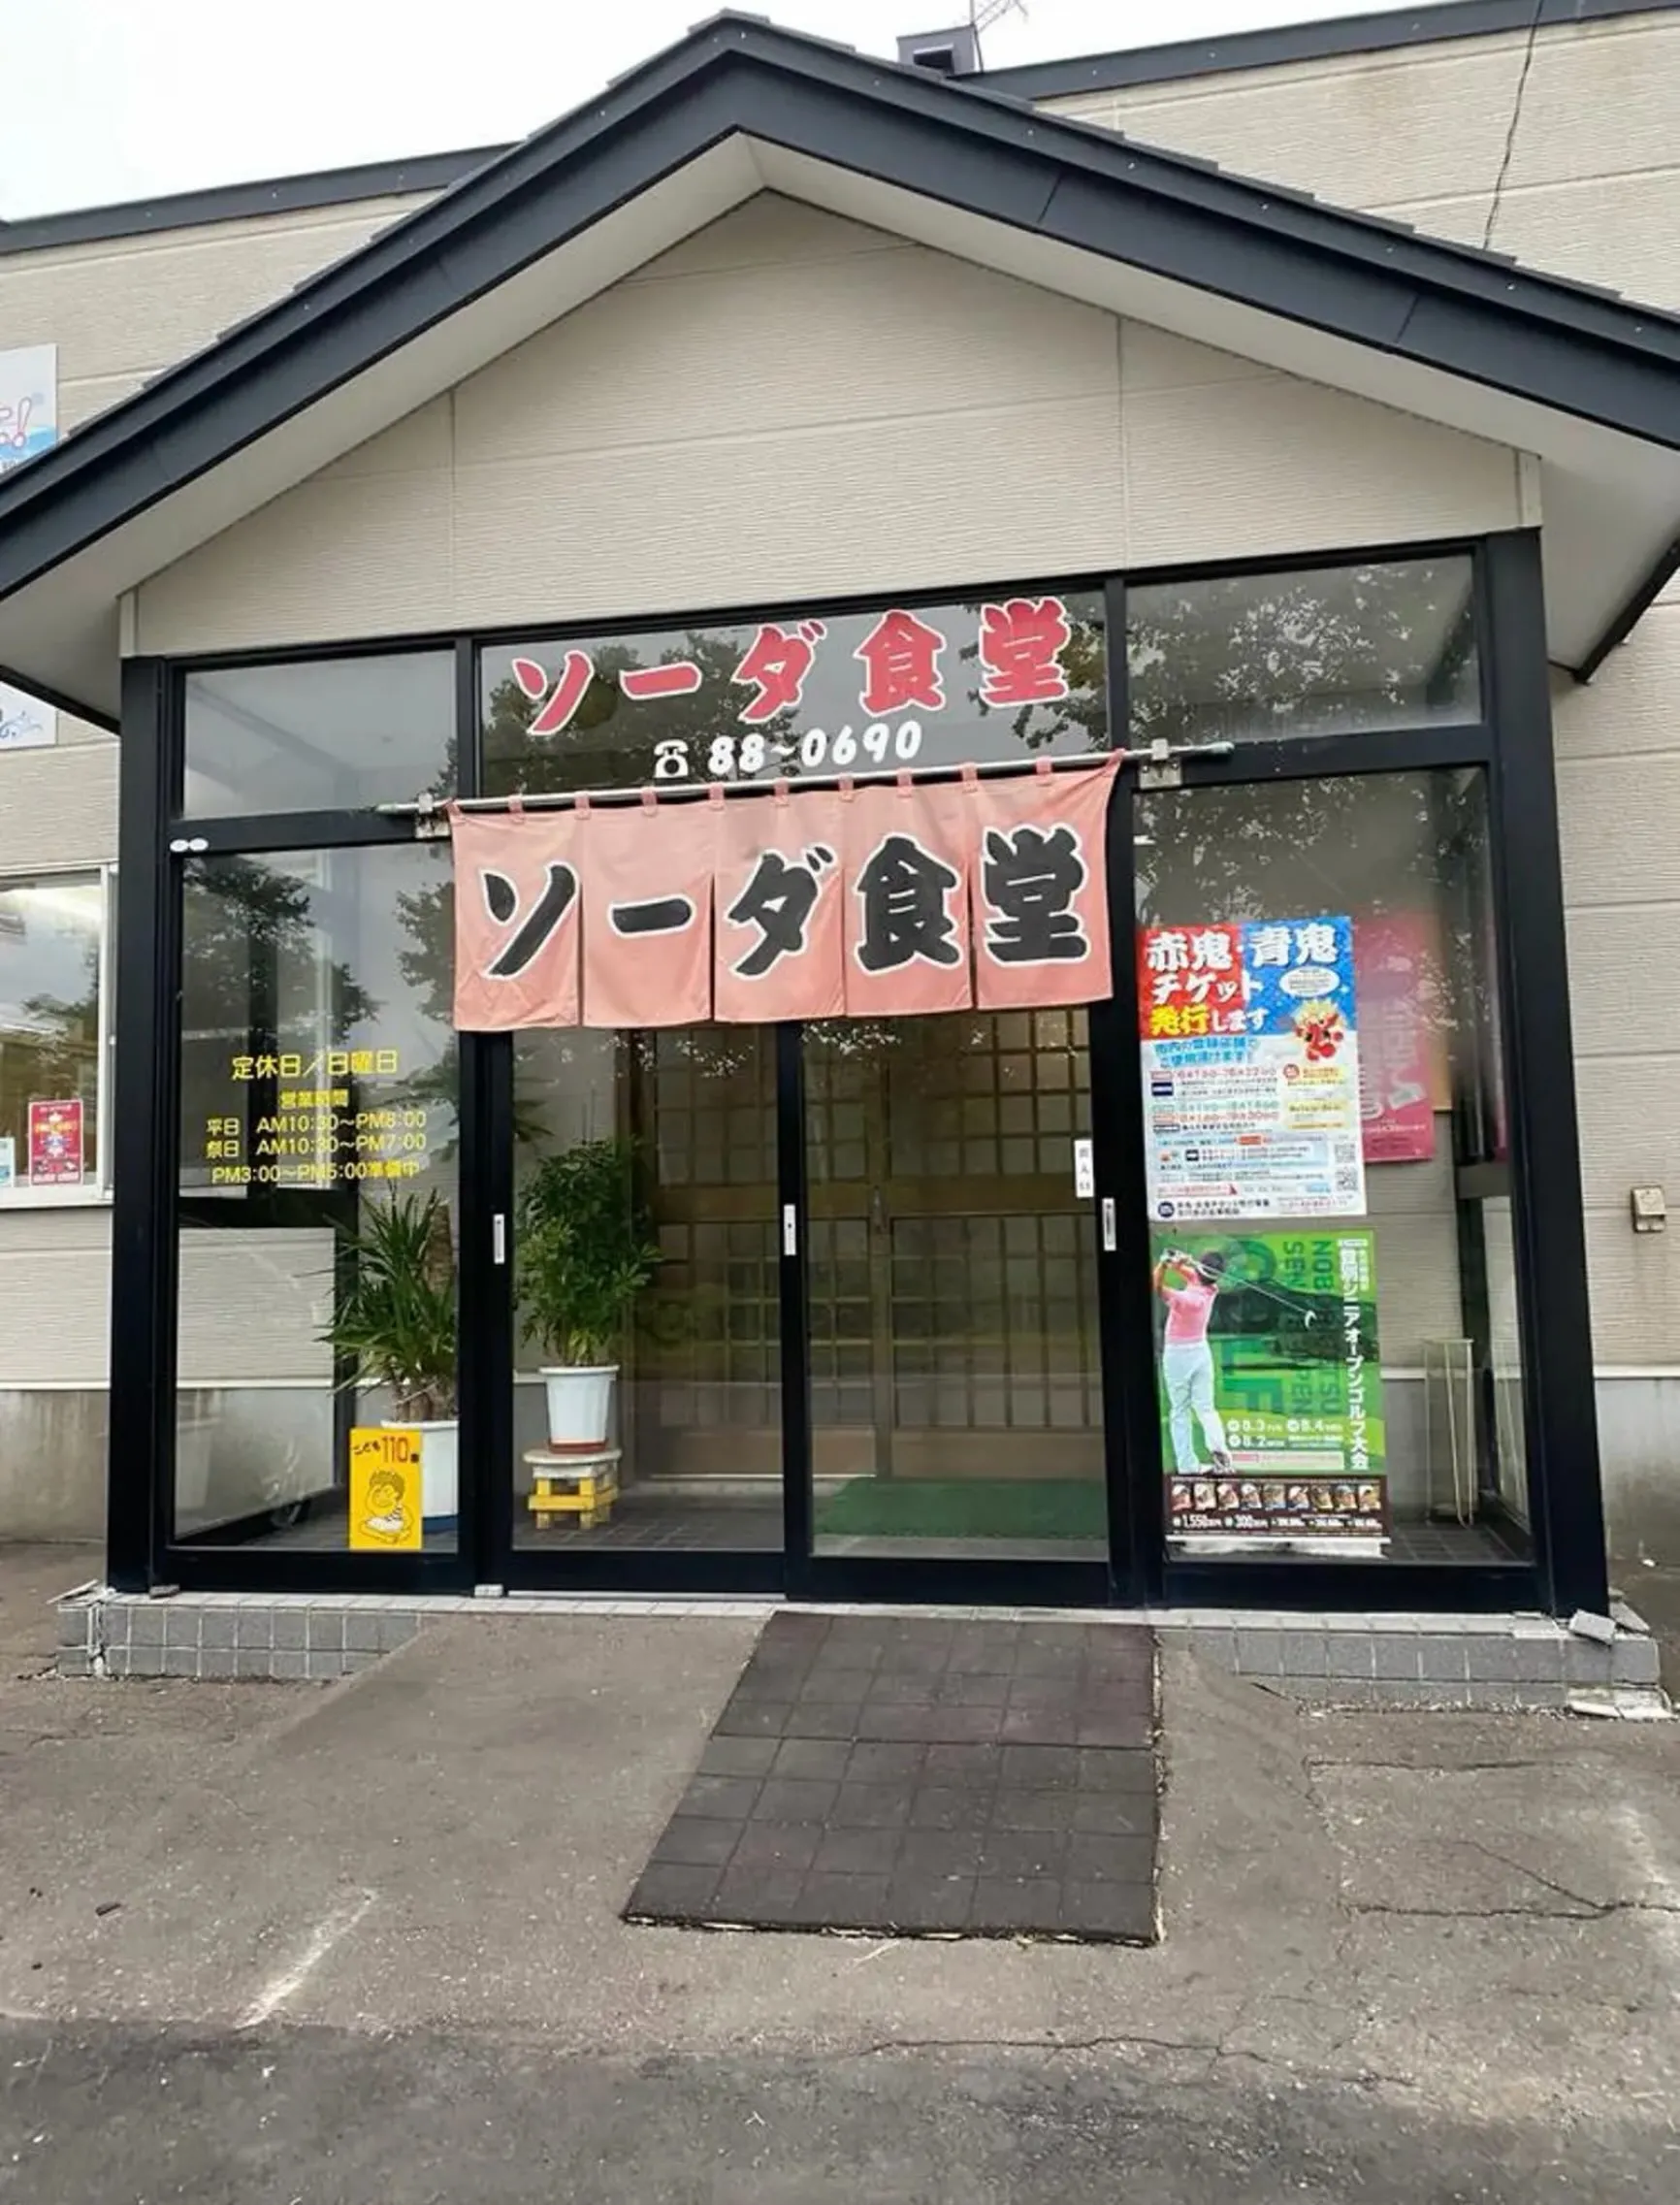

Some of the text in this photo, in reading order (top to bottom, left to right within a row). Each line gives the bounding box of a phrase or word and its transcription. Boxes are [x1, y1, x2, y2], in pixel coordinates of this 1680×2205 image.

[512, 596, 1071, 737] ソーダ食堂
[479, 823, 1091, 980] ソーダ食堂
[1152, 970, 1264, 1003] チケット
[1150, 1004, 1269, 1036] 発行します
[206, 1118, 241, 1136] 平日
